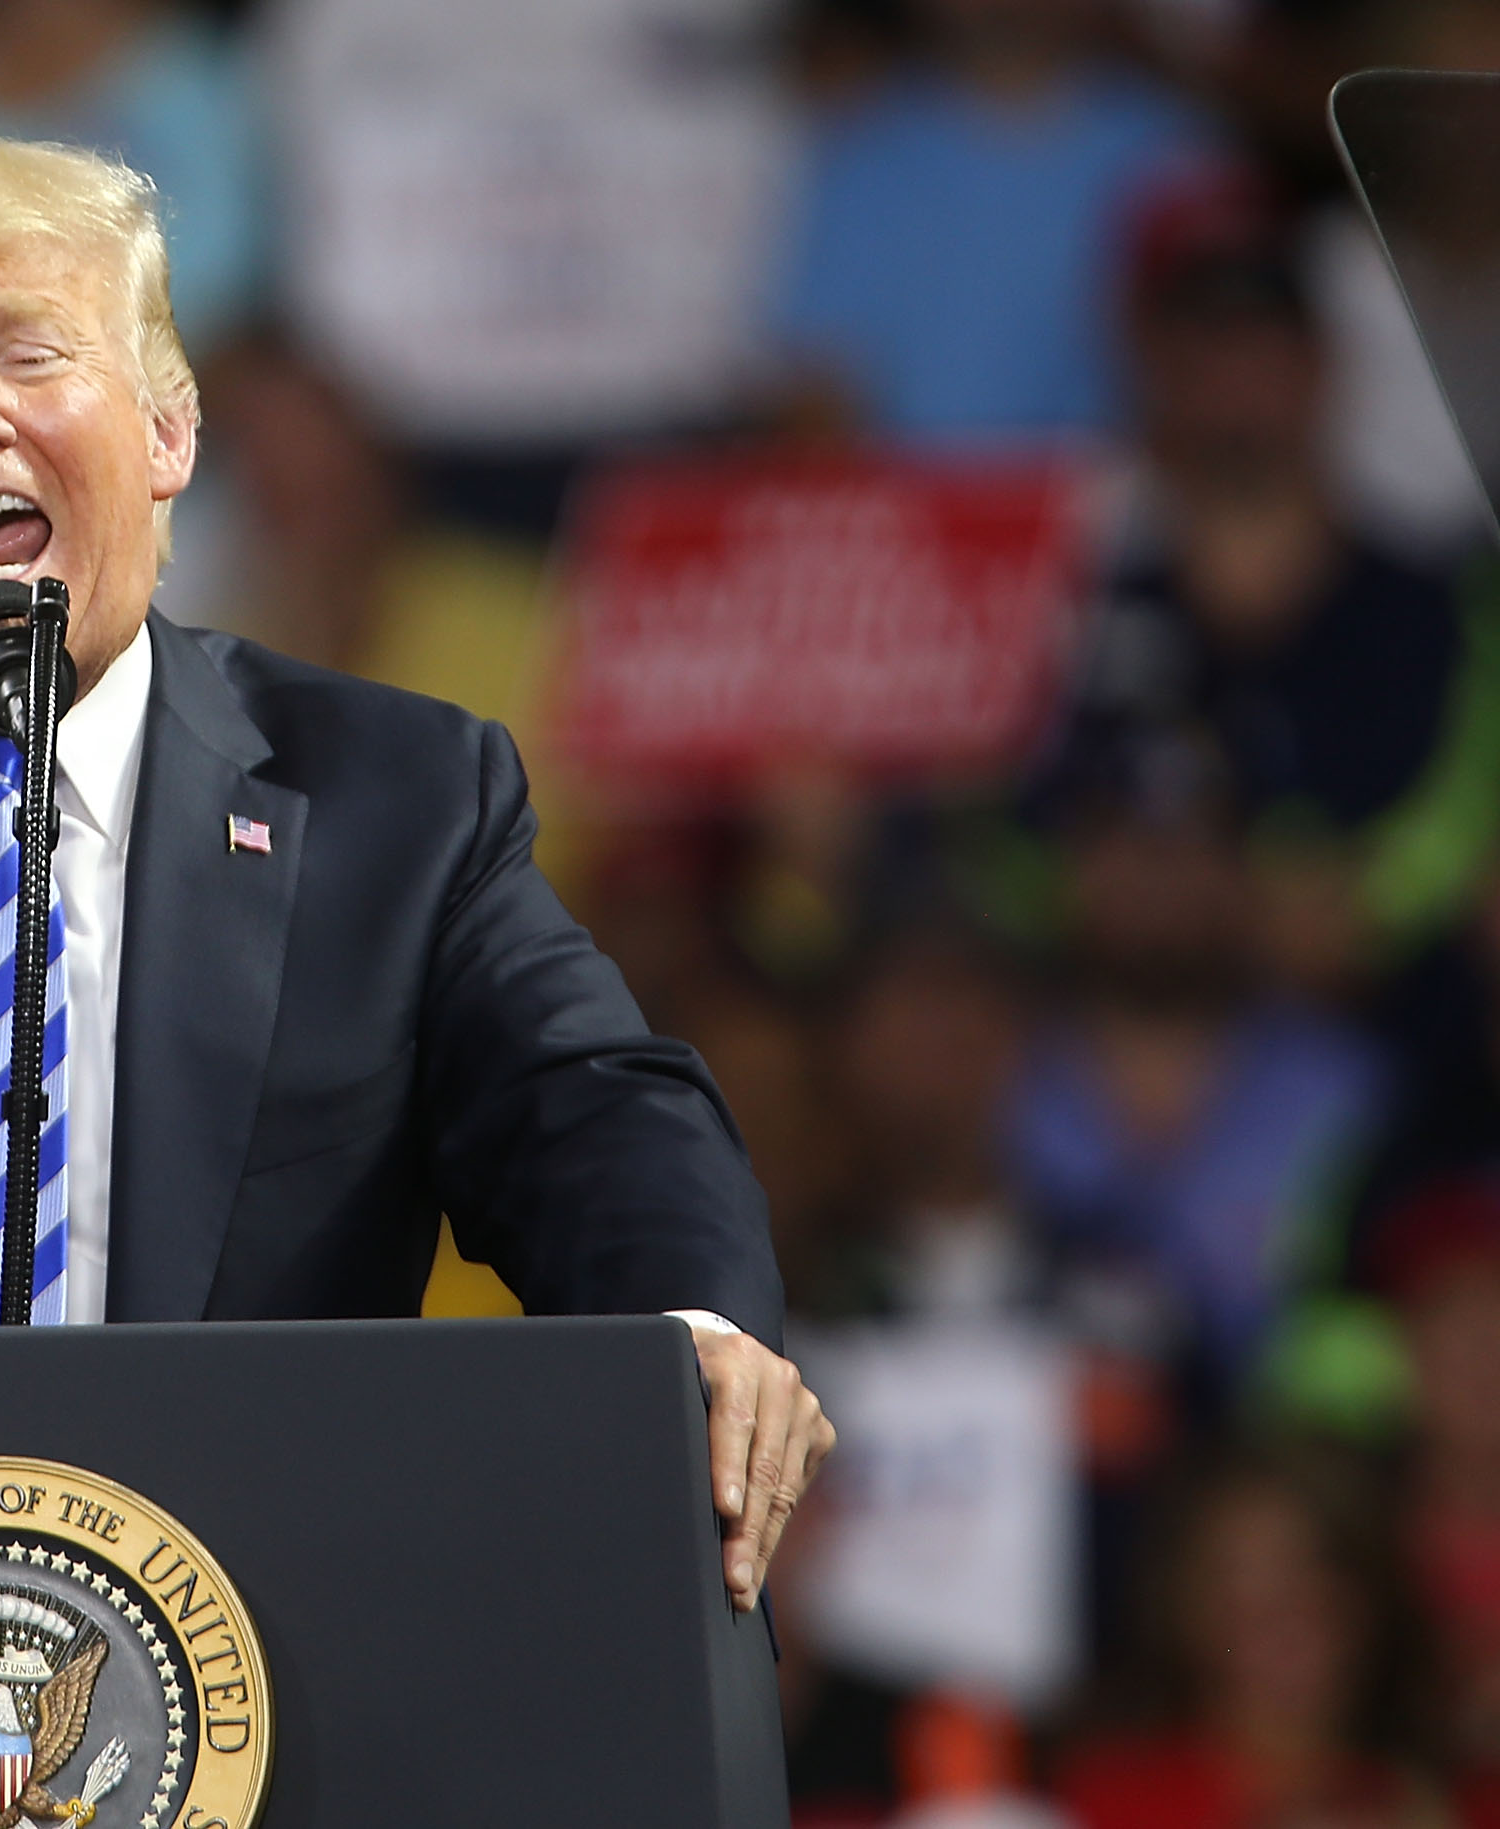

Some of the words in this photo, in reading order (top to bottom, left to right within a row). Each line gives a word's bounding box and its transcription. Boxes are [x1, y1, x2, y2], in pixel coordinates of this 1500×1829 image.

[10, 1663, 46, 1676] UNUM
[58, 1491, 126, 1544] THE
[139, 1536, 251, 1754] UNITED
